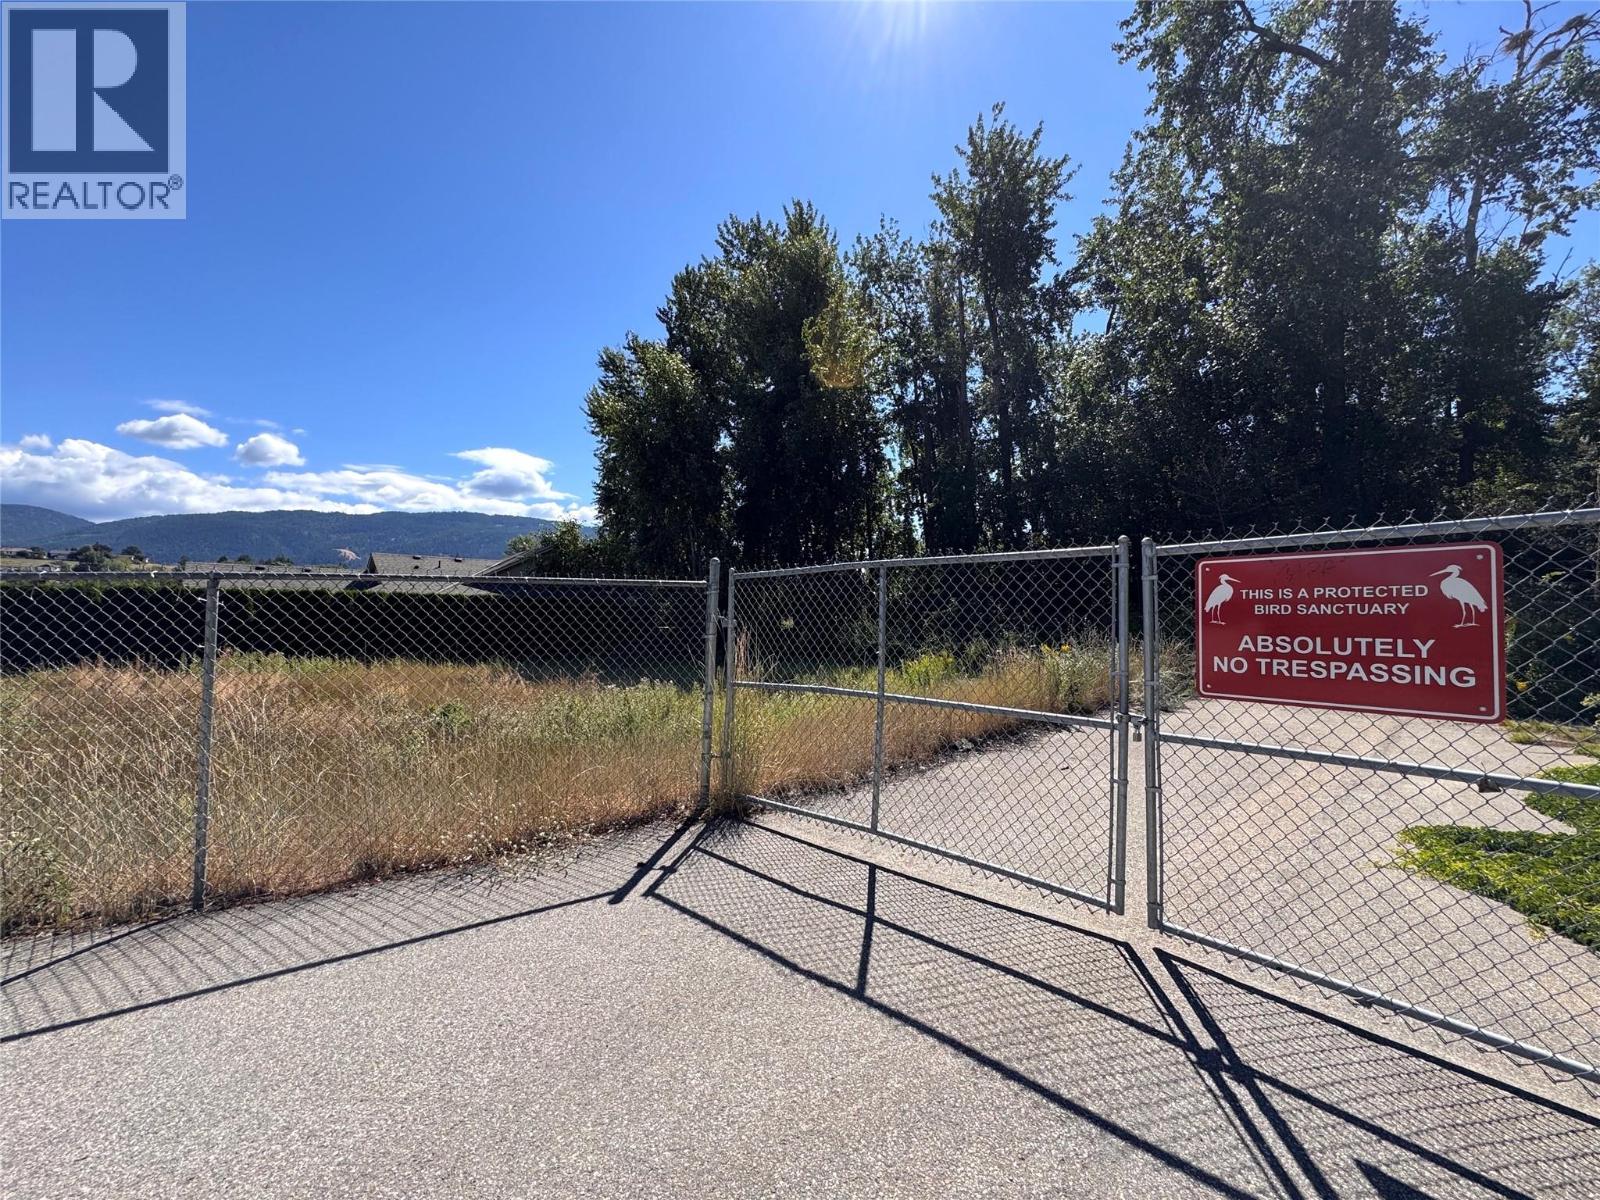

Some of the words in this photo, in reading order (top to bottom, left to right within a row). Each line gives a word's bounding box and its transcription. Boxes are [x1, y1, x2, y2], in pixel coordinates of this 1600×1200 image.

[1239, 588, 1274, 600] THIS
[1278, 588, 1293, 599] IS
[1297, 587, 1309, 599] A
[1313, 584, 1429, 599] PROTECTED
[1254, 604, 1292, 615] BIRD
[1296, 602, 1410, 616] SANCTUARY
[1237, 635, 1436, 659] ABSOLUTELY
[1212, 656, 1248, 674] NO
[1255, 657, 1477, 688] TRESPASSING
